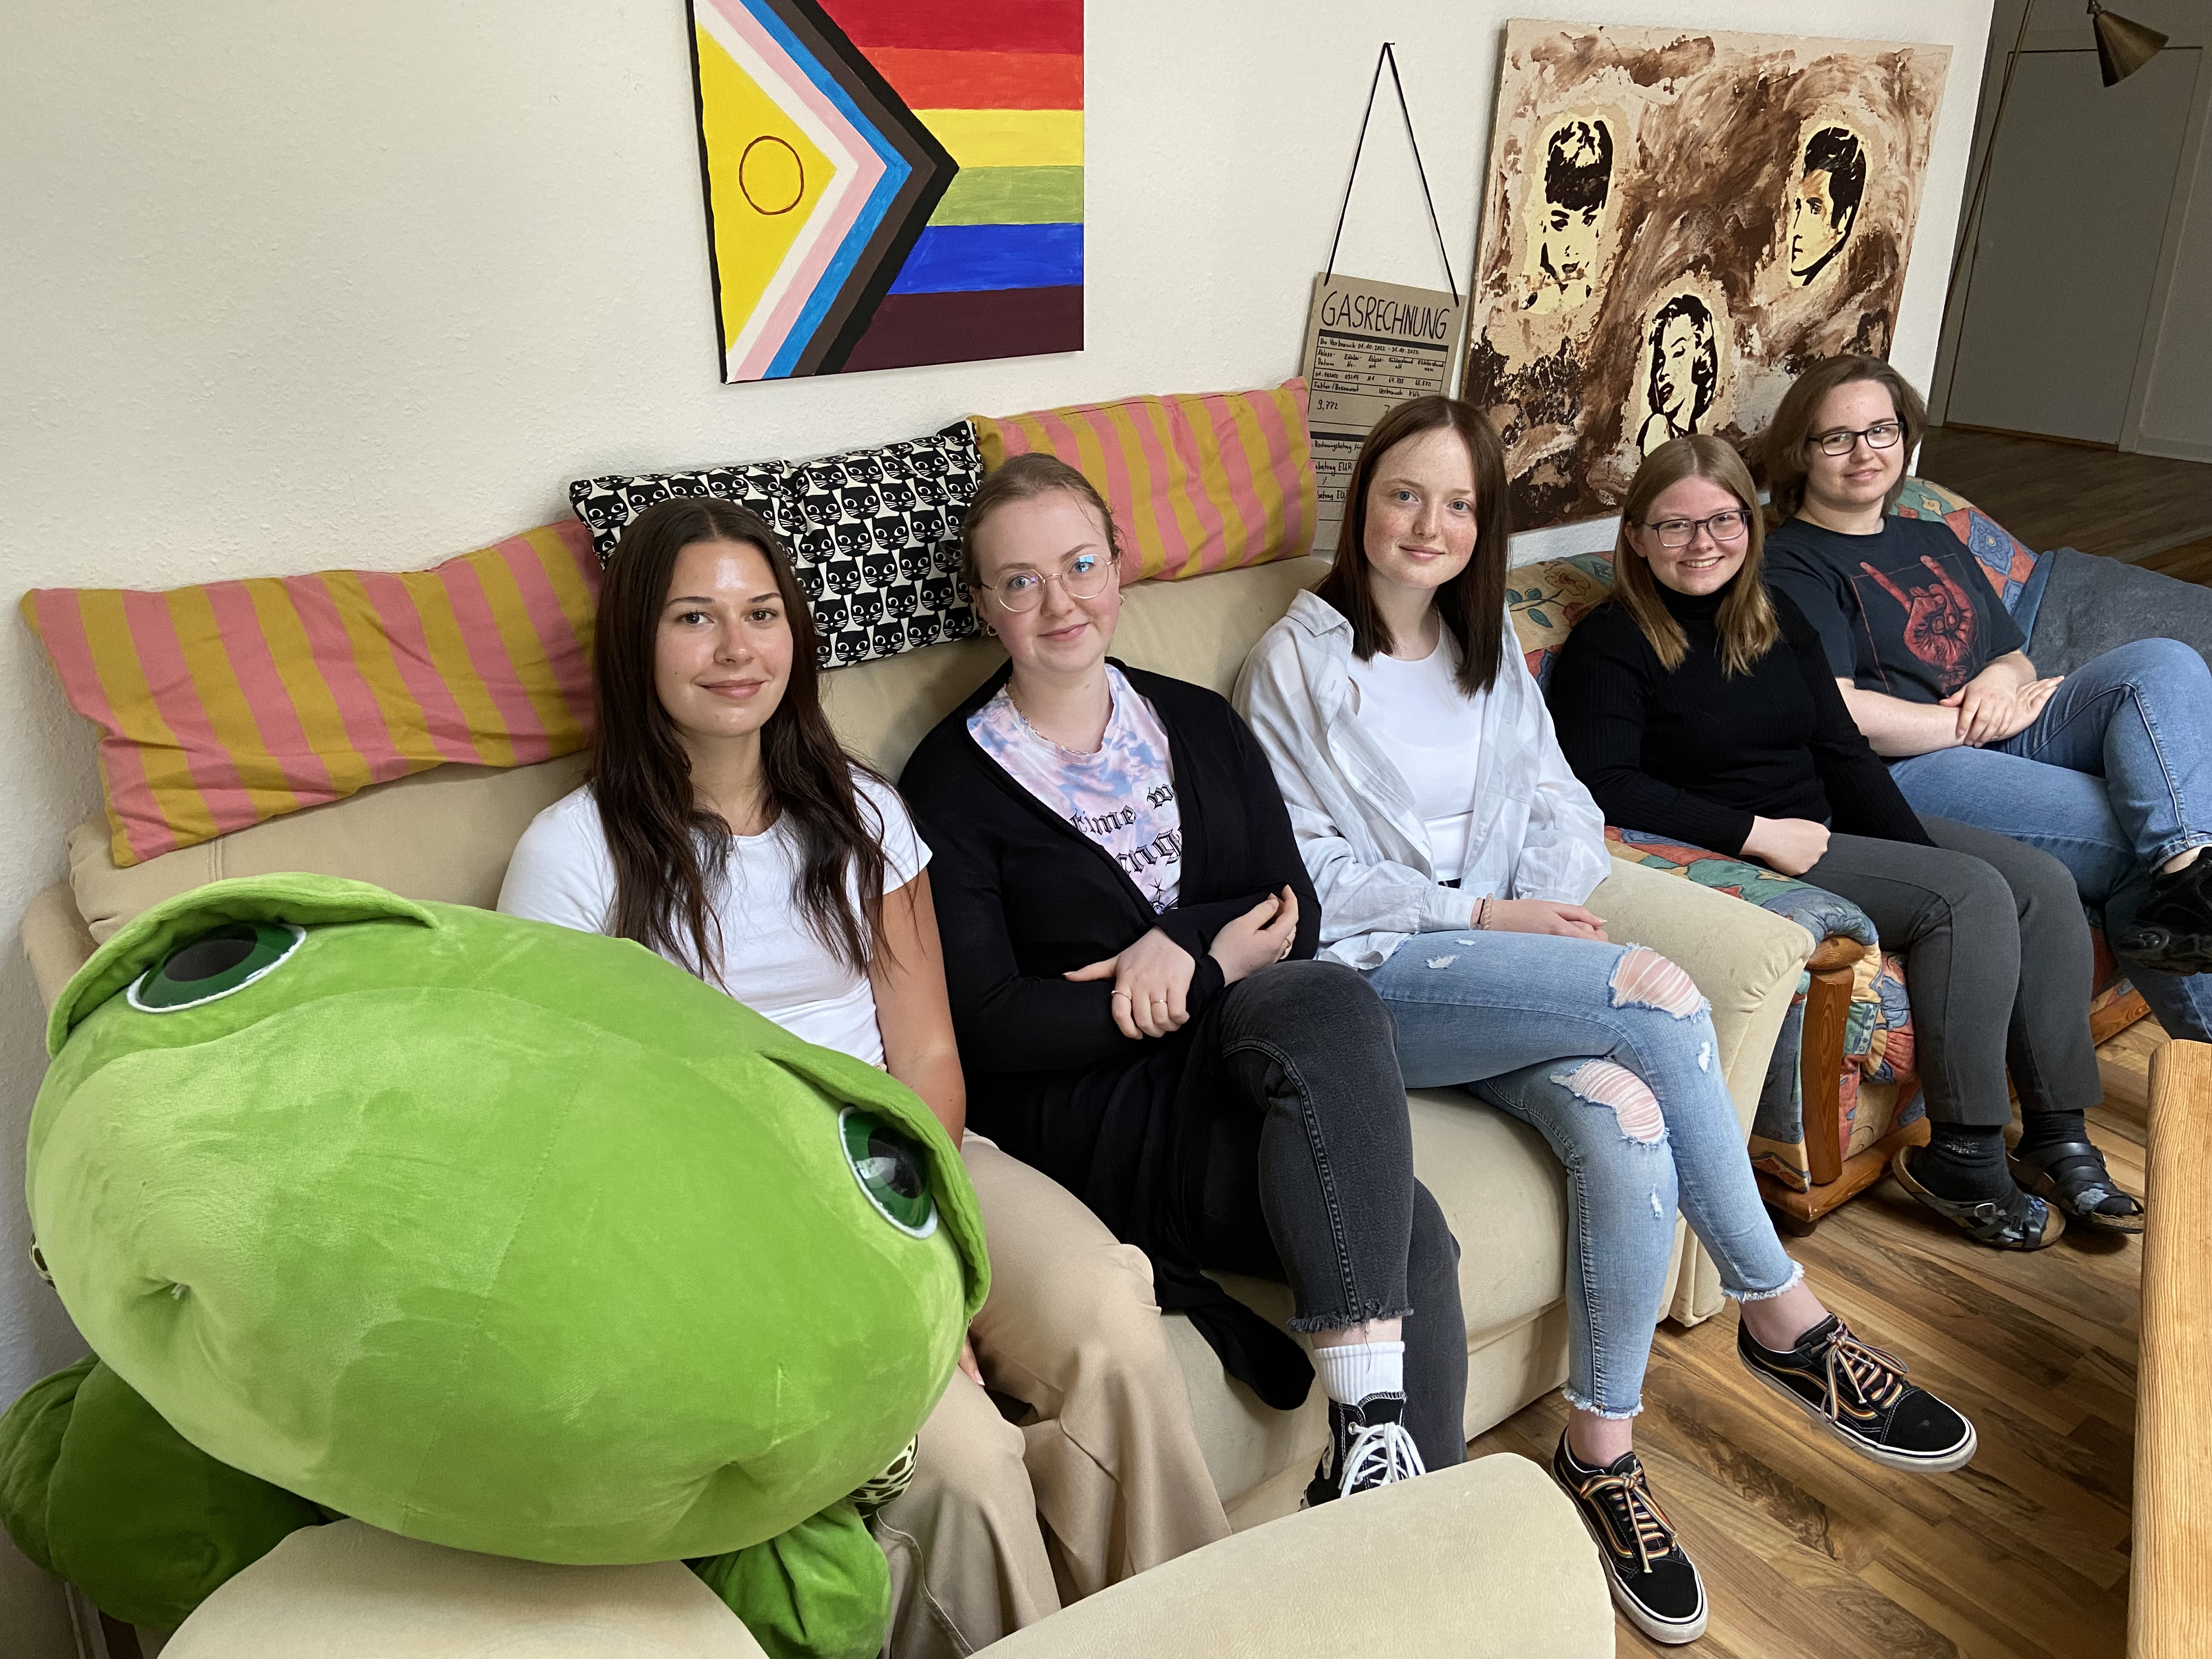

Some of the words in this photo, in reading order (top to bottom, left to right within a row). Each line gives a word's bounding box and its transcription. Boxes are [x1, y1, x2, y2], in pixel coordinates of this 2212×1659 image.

[1322, 291, 1450, 340] GASRECHNUNG
[1329, 338, 1356, 348] Verbrauch
[1379, 387, 1403, 396] Verbrauch
[1338, 462, 1352, 471] EUR
[1336, 489, 1349, 499] EU
